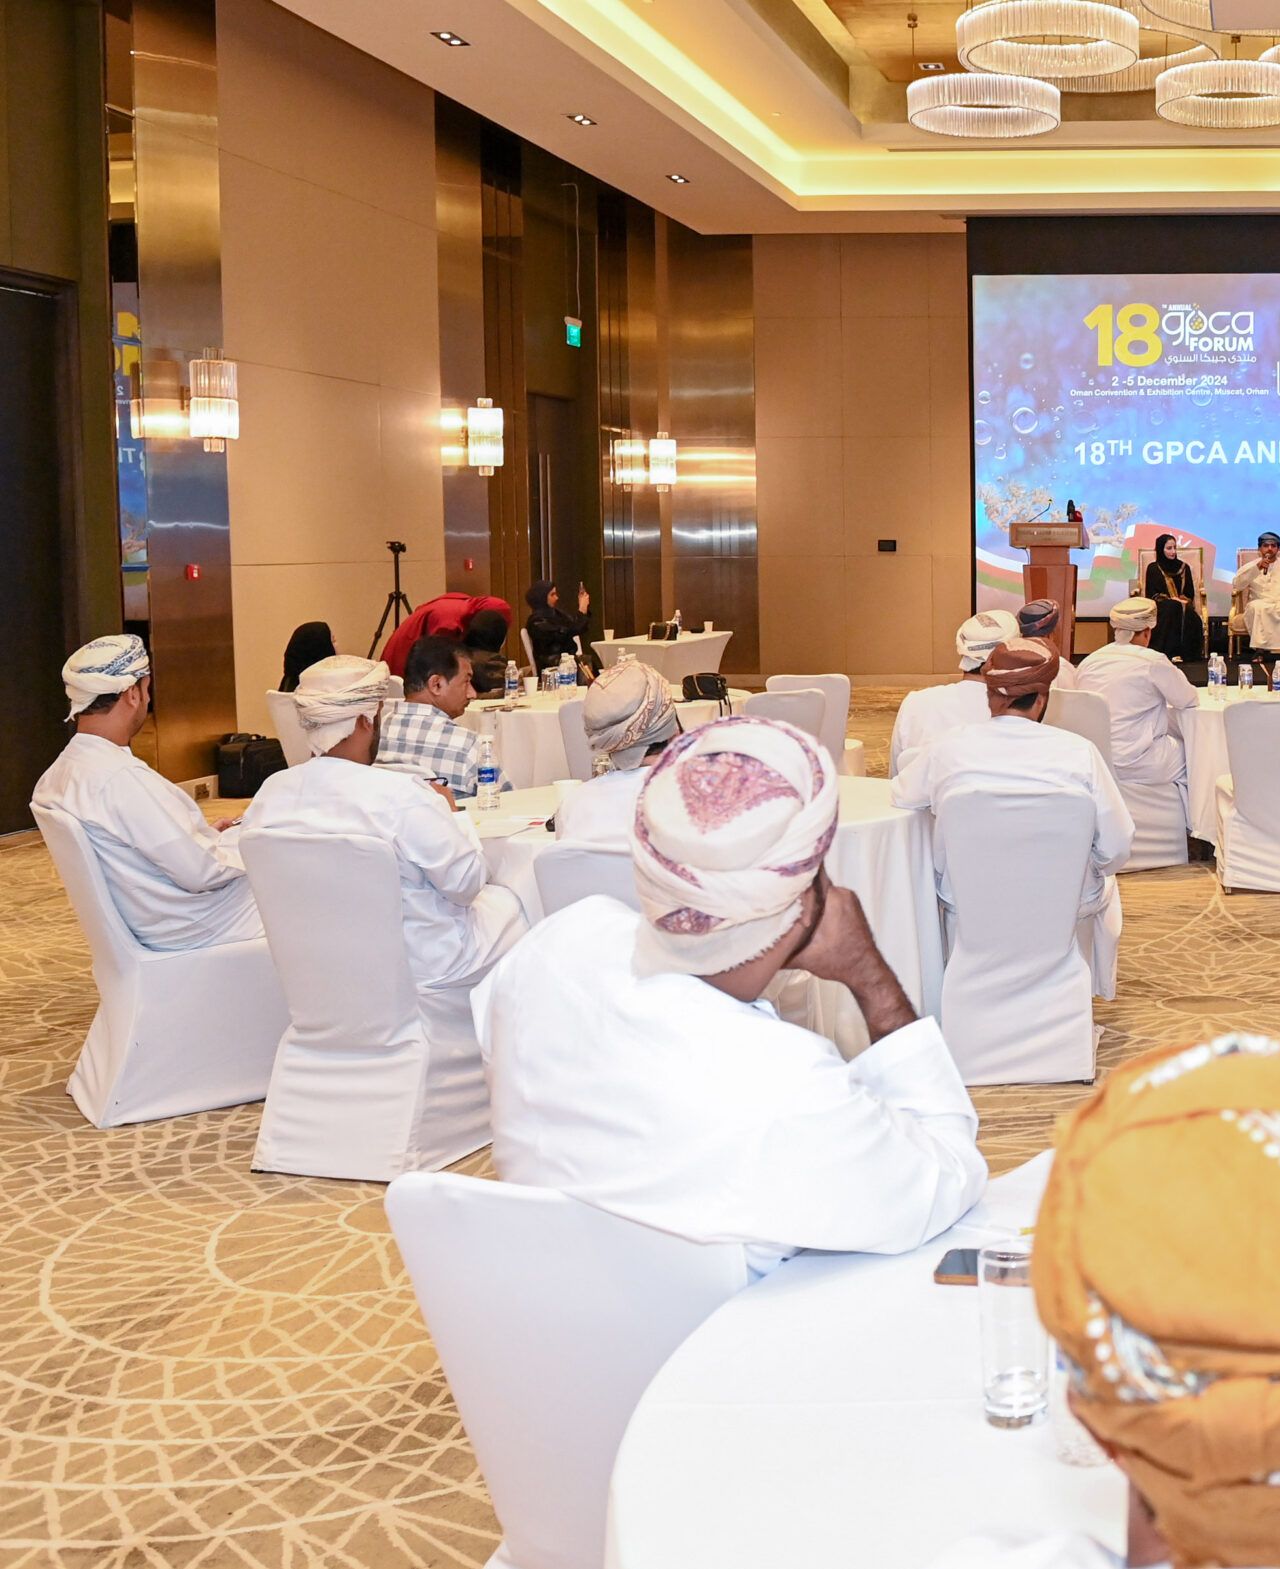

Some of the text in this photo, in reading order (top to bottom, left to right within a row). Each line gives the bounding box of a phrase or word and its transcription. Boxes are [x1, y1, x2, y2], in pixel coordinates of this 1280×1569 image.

[1082, 303, 1162, 368] 18
[1161, 310, 1254, 346] gpca
[1190, 336, 1254, 352] FORUM
[1111, 376, 1119, 387] 2
[1137, 375, 1198, 387] December
[1200, 375, 1229, 387] 2024
[1070, 389, 1093, 397] Oman
[1094, 389, 1138, 397] Convention
[1146, 388, 1184, 397] Exhibition
[1214, 388, 1245, 396] Muscat,
[1245, 388, 1269, 396] Oman
[1074, 440, 1132, 466] 18TH
[1142, 440, 1228, 465] GPCA
